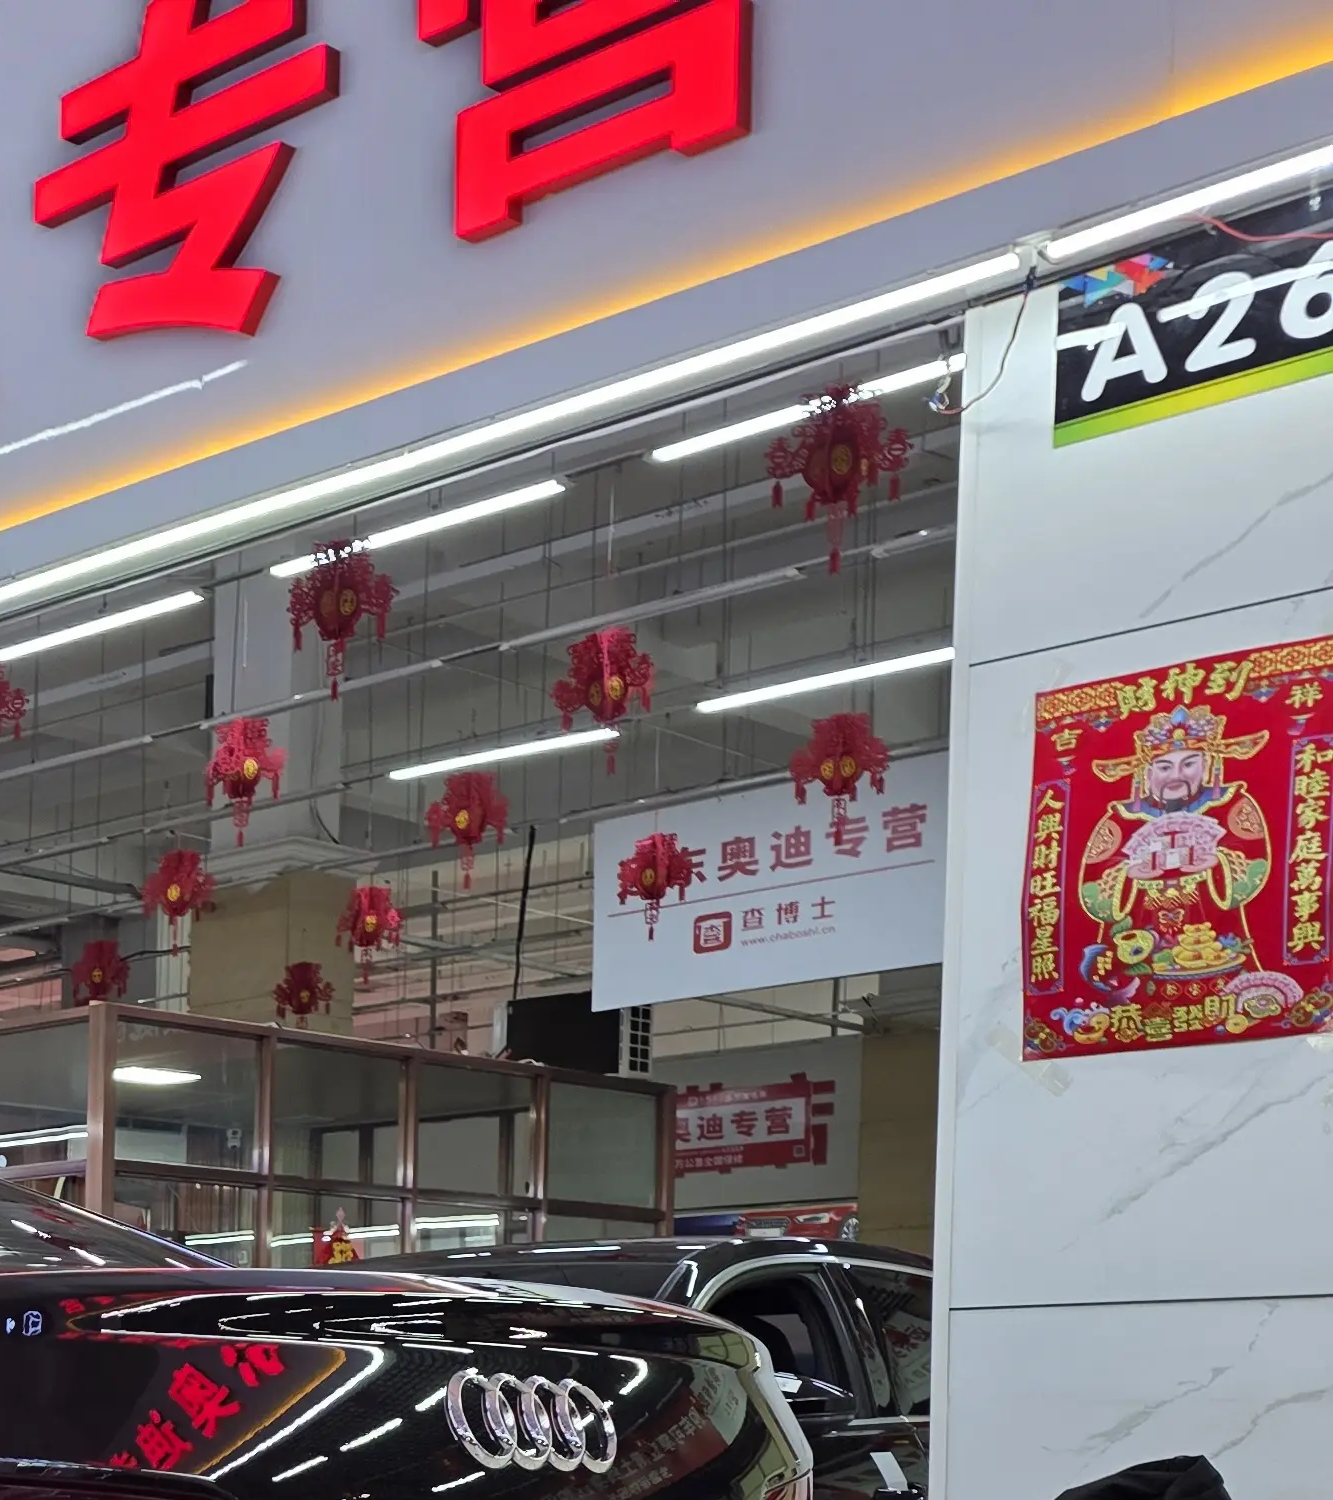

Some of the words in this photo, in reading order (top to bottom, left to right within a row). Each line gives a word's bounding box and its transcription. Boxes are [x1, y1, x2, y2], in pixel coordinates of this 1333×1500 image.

[1081, 240, 1333, 402] A26
[740, 896, 836, 932] 查博士
